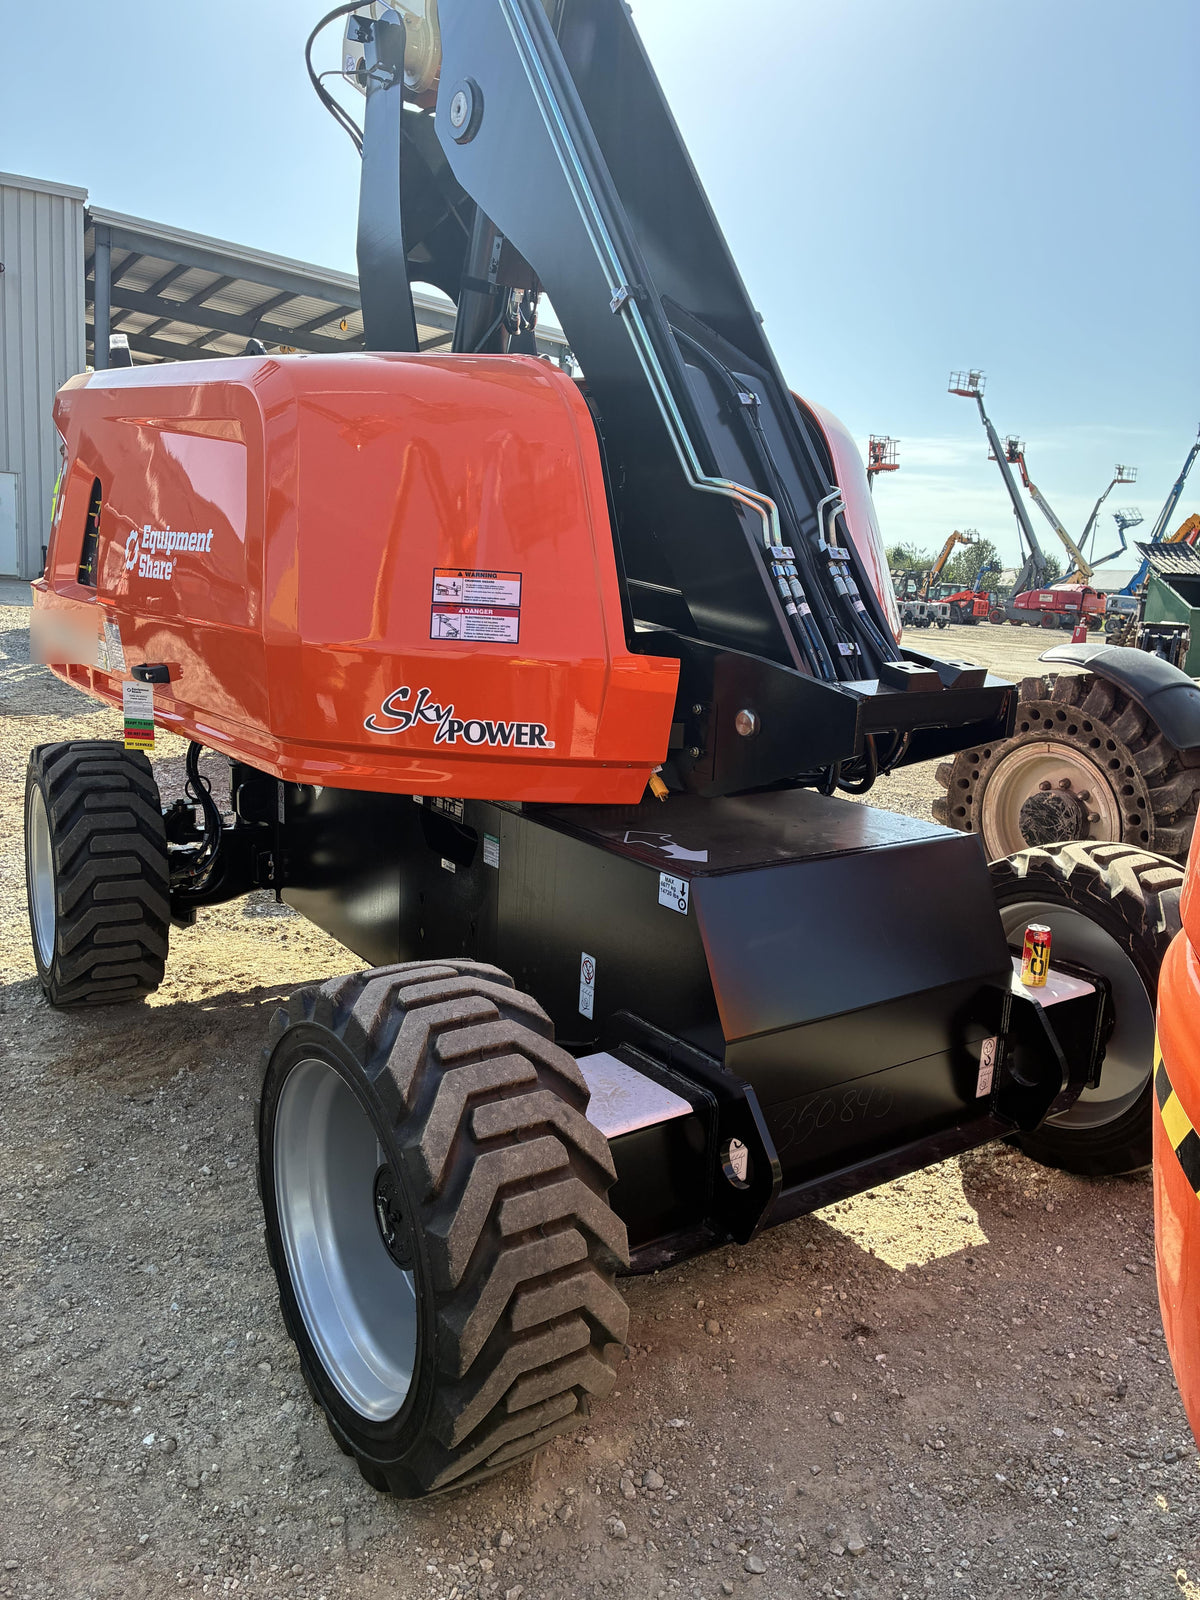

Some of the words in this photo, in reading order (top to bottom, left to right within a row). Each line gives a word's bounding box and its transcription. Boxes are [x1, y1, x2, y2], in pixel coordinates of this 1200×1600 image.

[141, 524, 214, 556] Equipment
[138, 554, 173, 581] Share
[465, 571, 497, 579] WARNING
[465, 607, 493, 615] DANGER
[1031, 941, 1047, 976] C4
